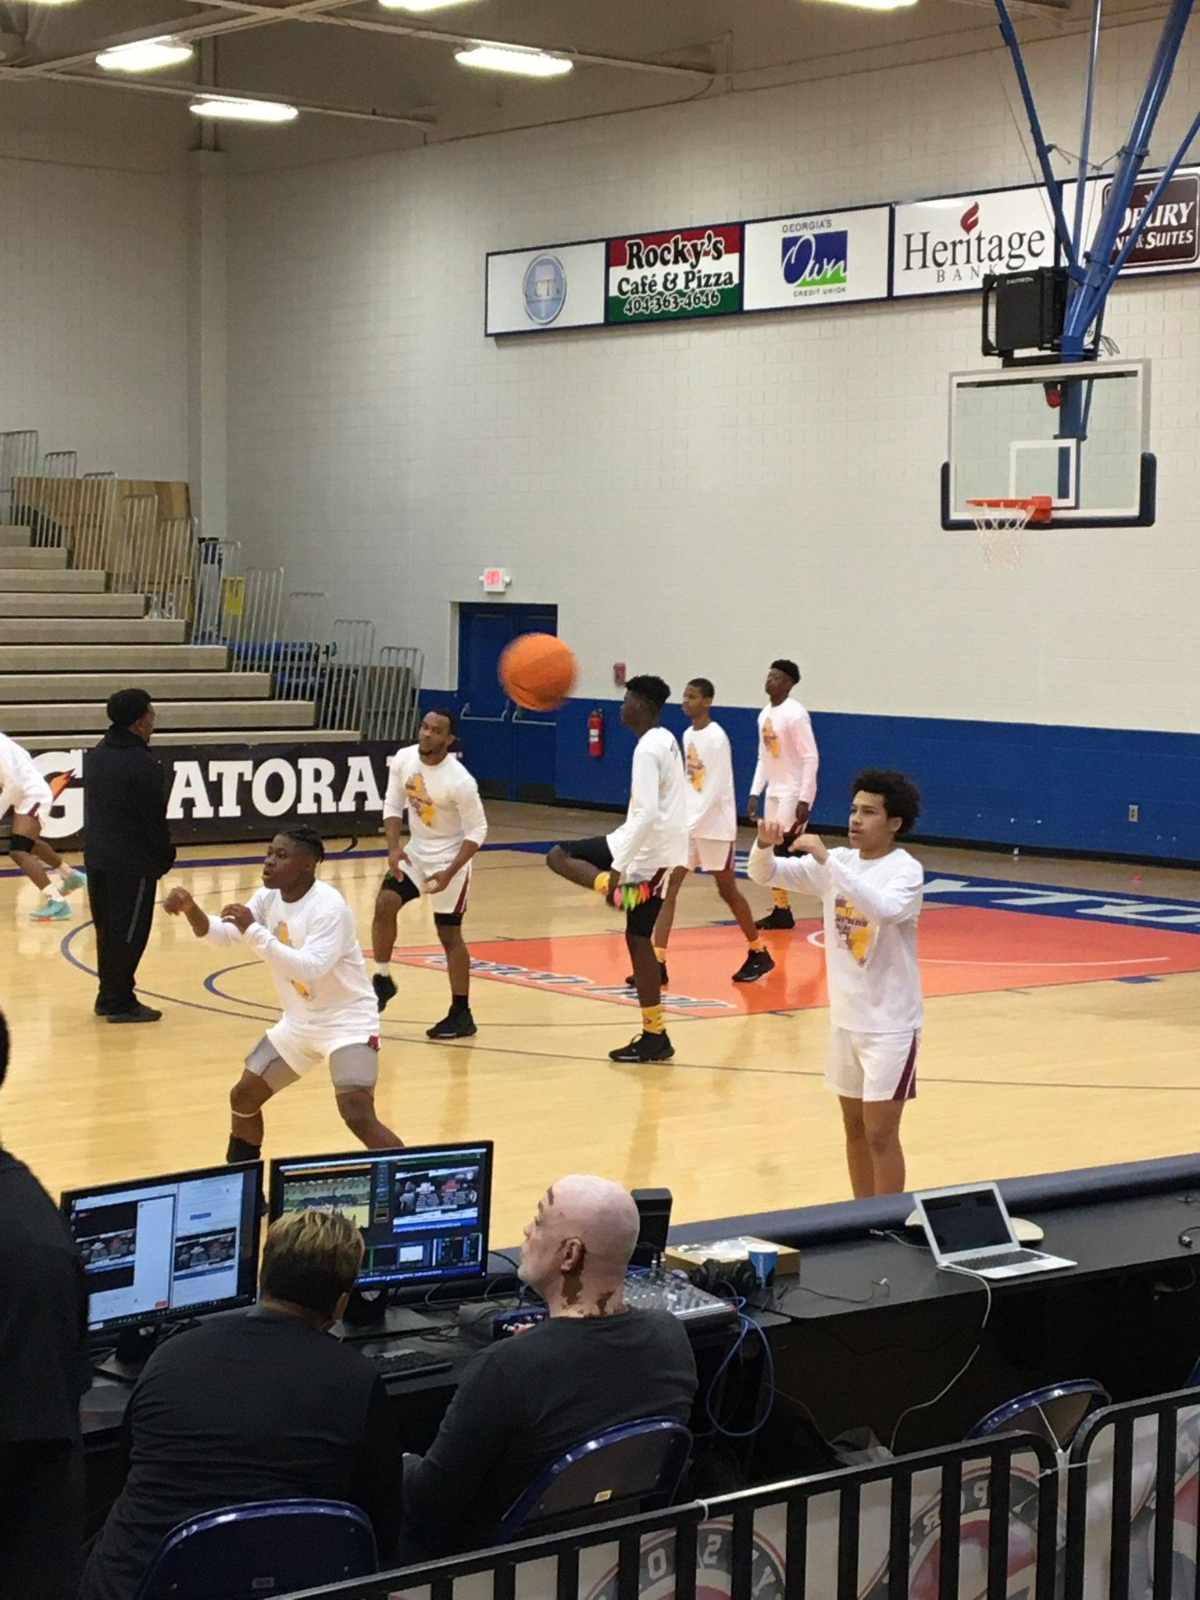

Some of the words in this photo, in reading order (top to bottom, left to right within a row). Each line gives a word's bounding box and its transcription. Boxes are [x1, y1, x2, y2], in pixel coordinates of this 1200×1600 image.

[782, 219, 832, 233] GEORGIA'S
[626, 231, 724, 270] Rocky's
[902, 230, 1045, 270] Heritage
[1145, 230, 1194, 249] SUITES
[783, 234, 848, 284] Own
[618, 274, 657, 296] Café
[662, 272, 678, 291] &
[684, 270, 733, 290] Pizza
[936, 264, 998, 283] BANK
[625, 290, 719, 314] 404-363-4646
[793, 288, 820, 298] CREDIT
[823, 286, 846, 295] UNION
[166, 756, 396, 819] ATORA
